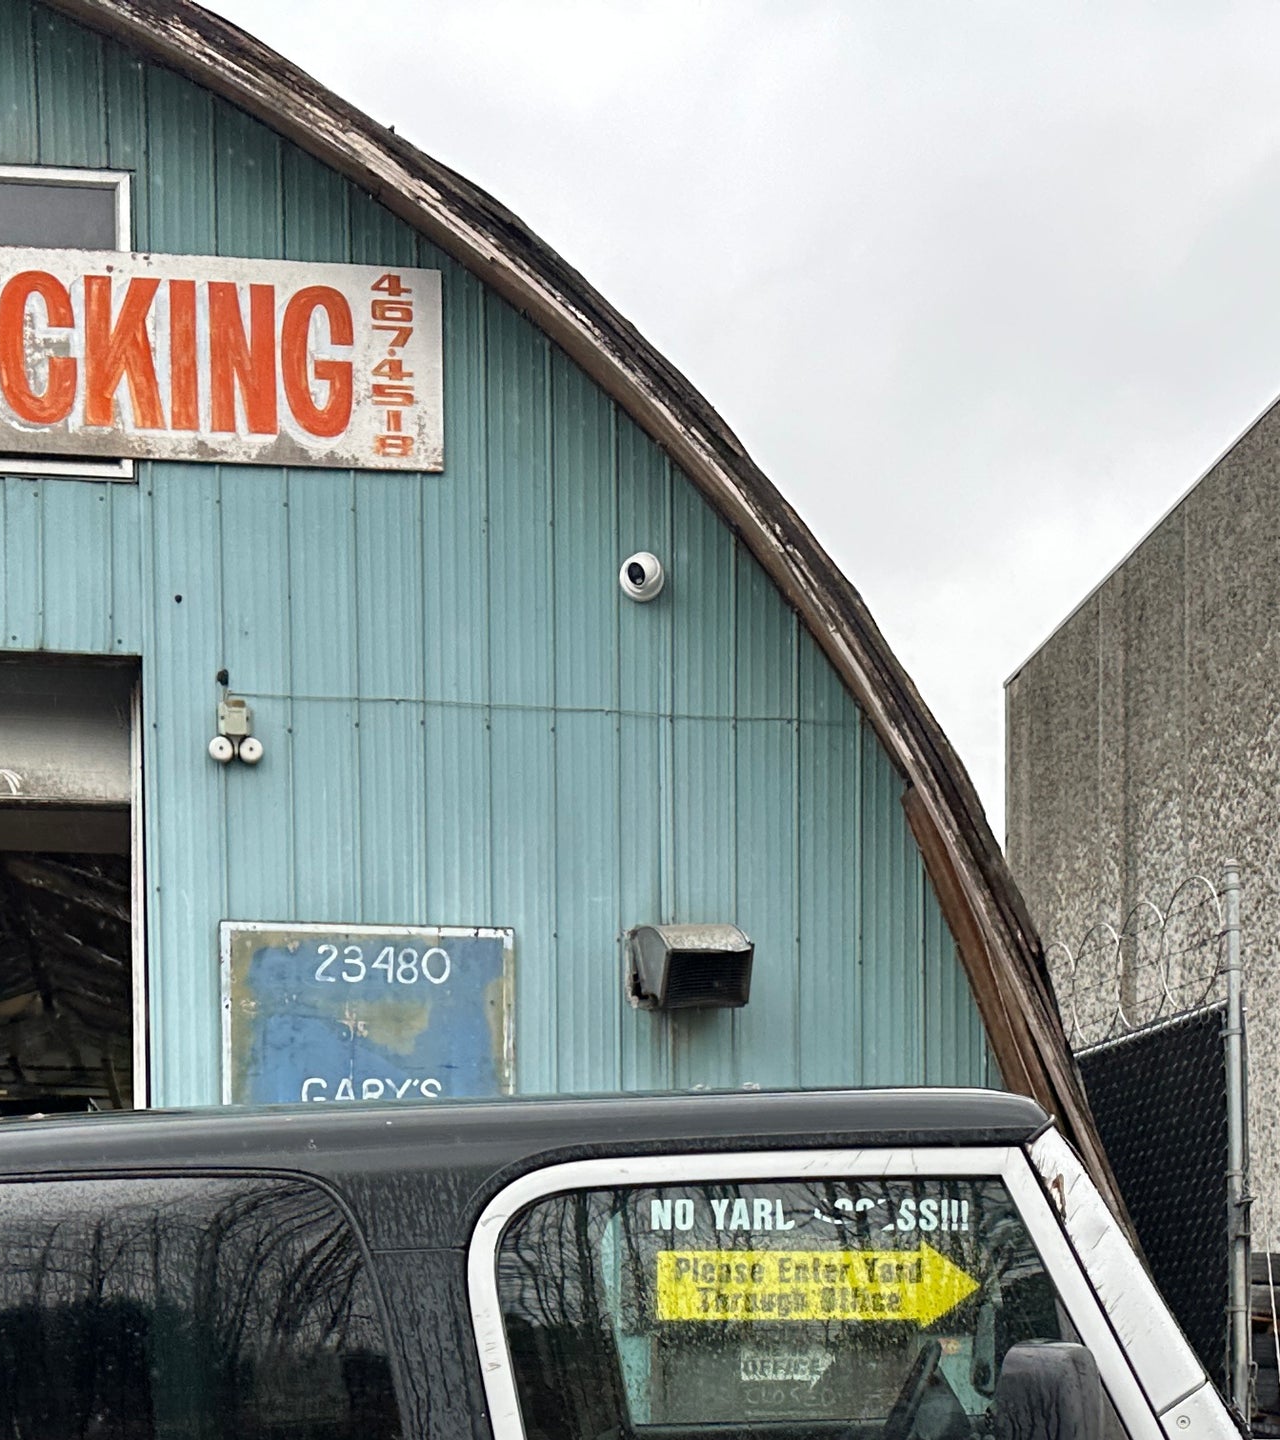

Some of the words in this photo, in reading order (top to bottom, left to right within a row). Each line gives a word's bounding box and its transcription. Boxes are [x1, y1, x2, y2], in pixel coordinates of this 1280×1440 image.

[315, 944, 451, 984] 23480
[650, 1198, 695, 1231] NO
[675, 1257, 764, 1284] Please
